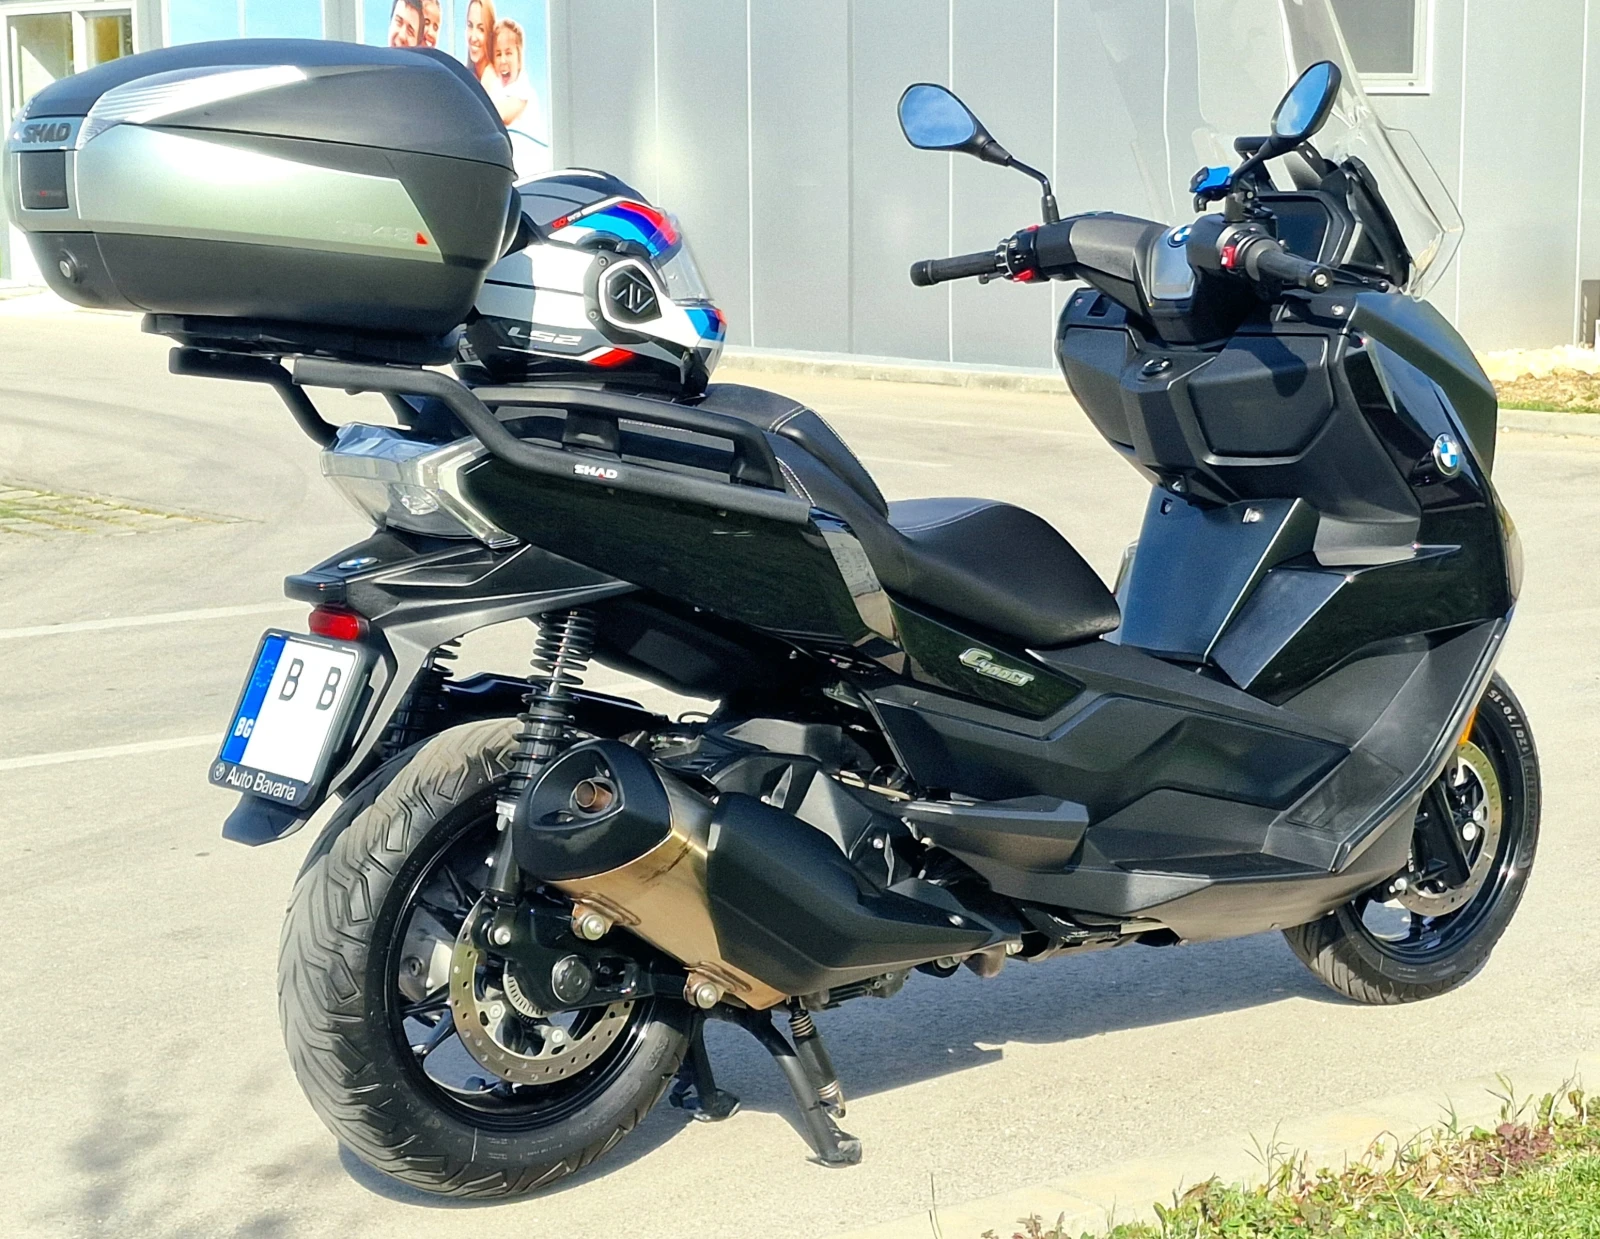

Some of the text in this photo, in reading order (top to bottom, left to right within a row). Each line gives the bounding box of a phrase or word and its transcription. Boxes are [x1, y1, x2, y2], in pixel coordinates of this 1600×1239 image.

[22, 122, 71, 143] SHAD
[508, 327, 582, 346] LS2
[574, 464, 618, 479] SHAD
[278, 657, 342, 711] B B
[233, 716, 255, 738] BG
[1487, 689, 1530, 753] 120/70-15
[225, 766, 297, 801] Auto Bavaria
